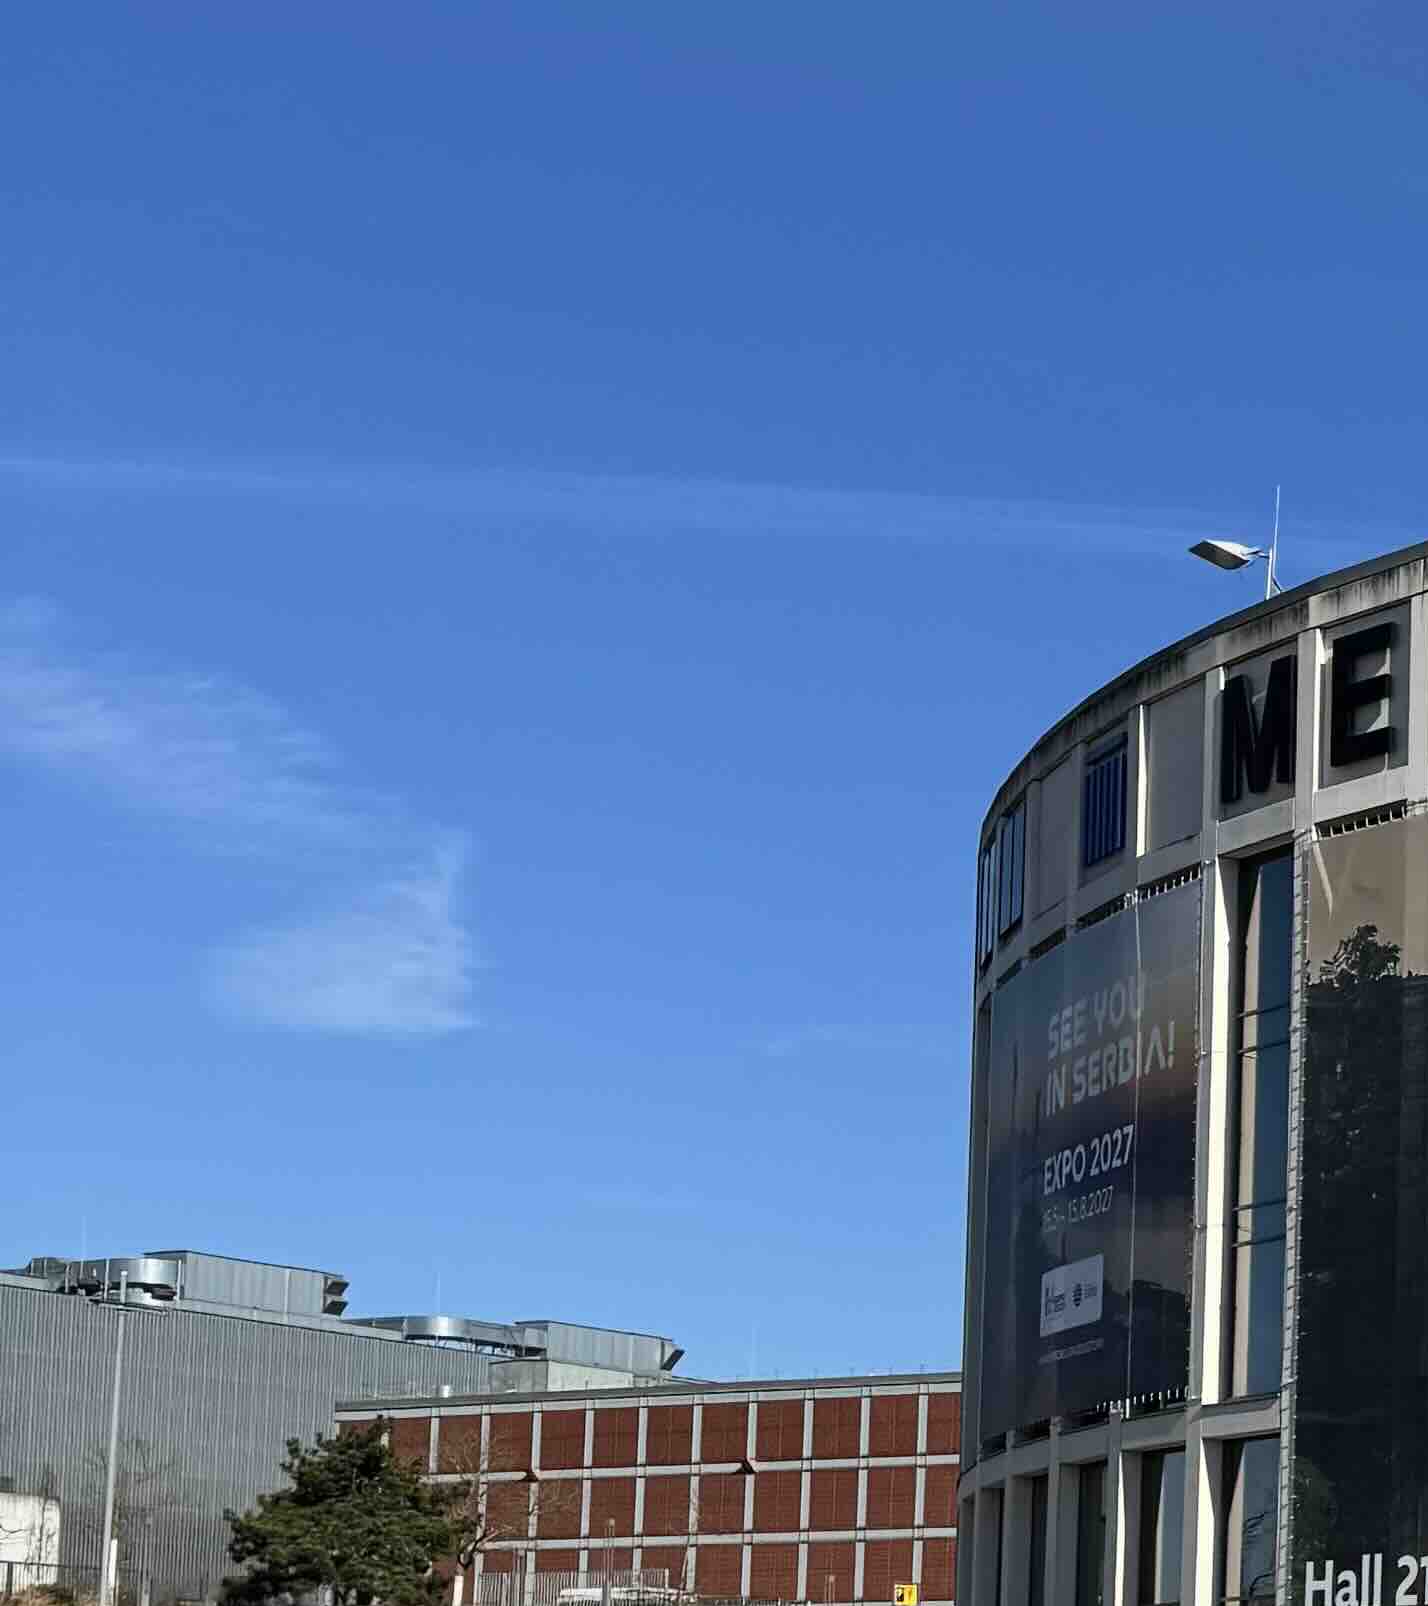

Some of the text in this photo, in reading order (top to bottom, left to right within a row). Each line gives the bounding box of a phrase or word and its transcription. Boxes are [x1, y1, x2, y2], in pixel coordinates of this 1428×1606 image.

[1047, 973, 1145, 1061] SEE YOU
[1046, 1063, 1067, 1118] IN
[1043, 1123, 1134, 1196] EXPO 2027
